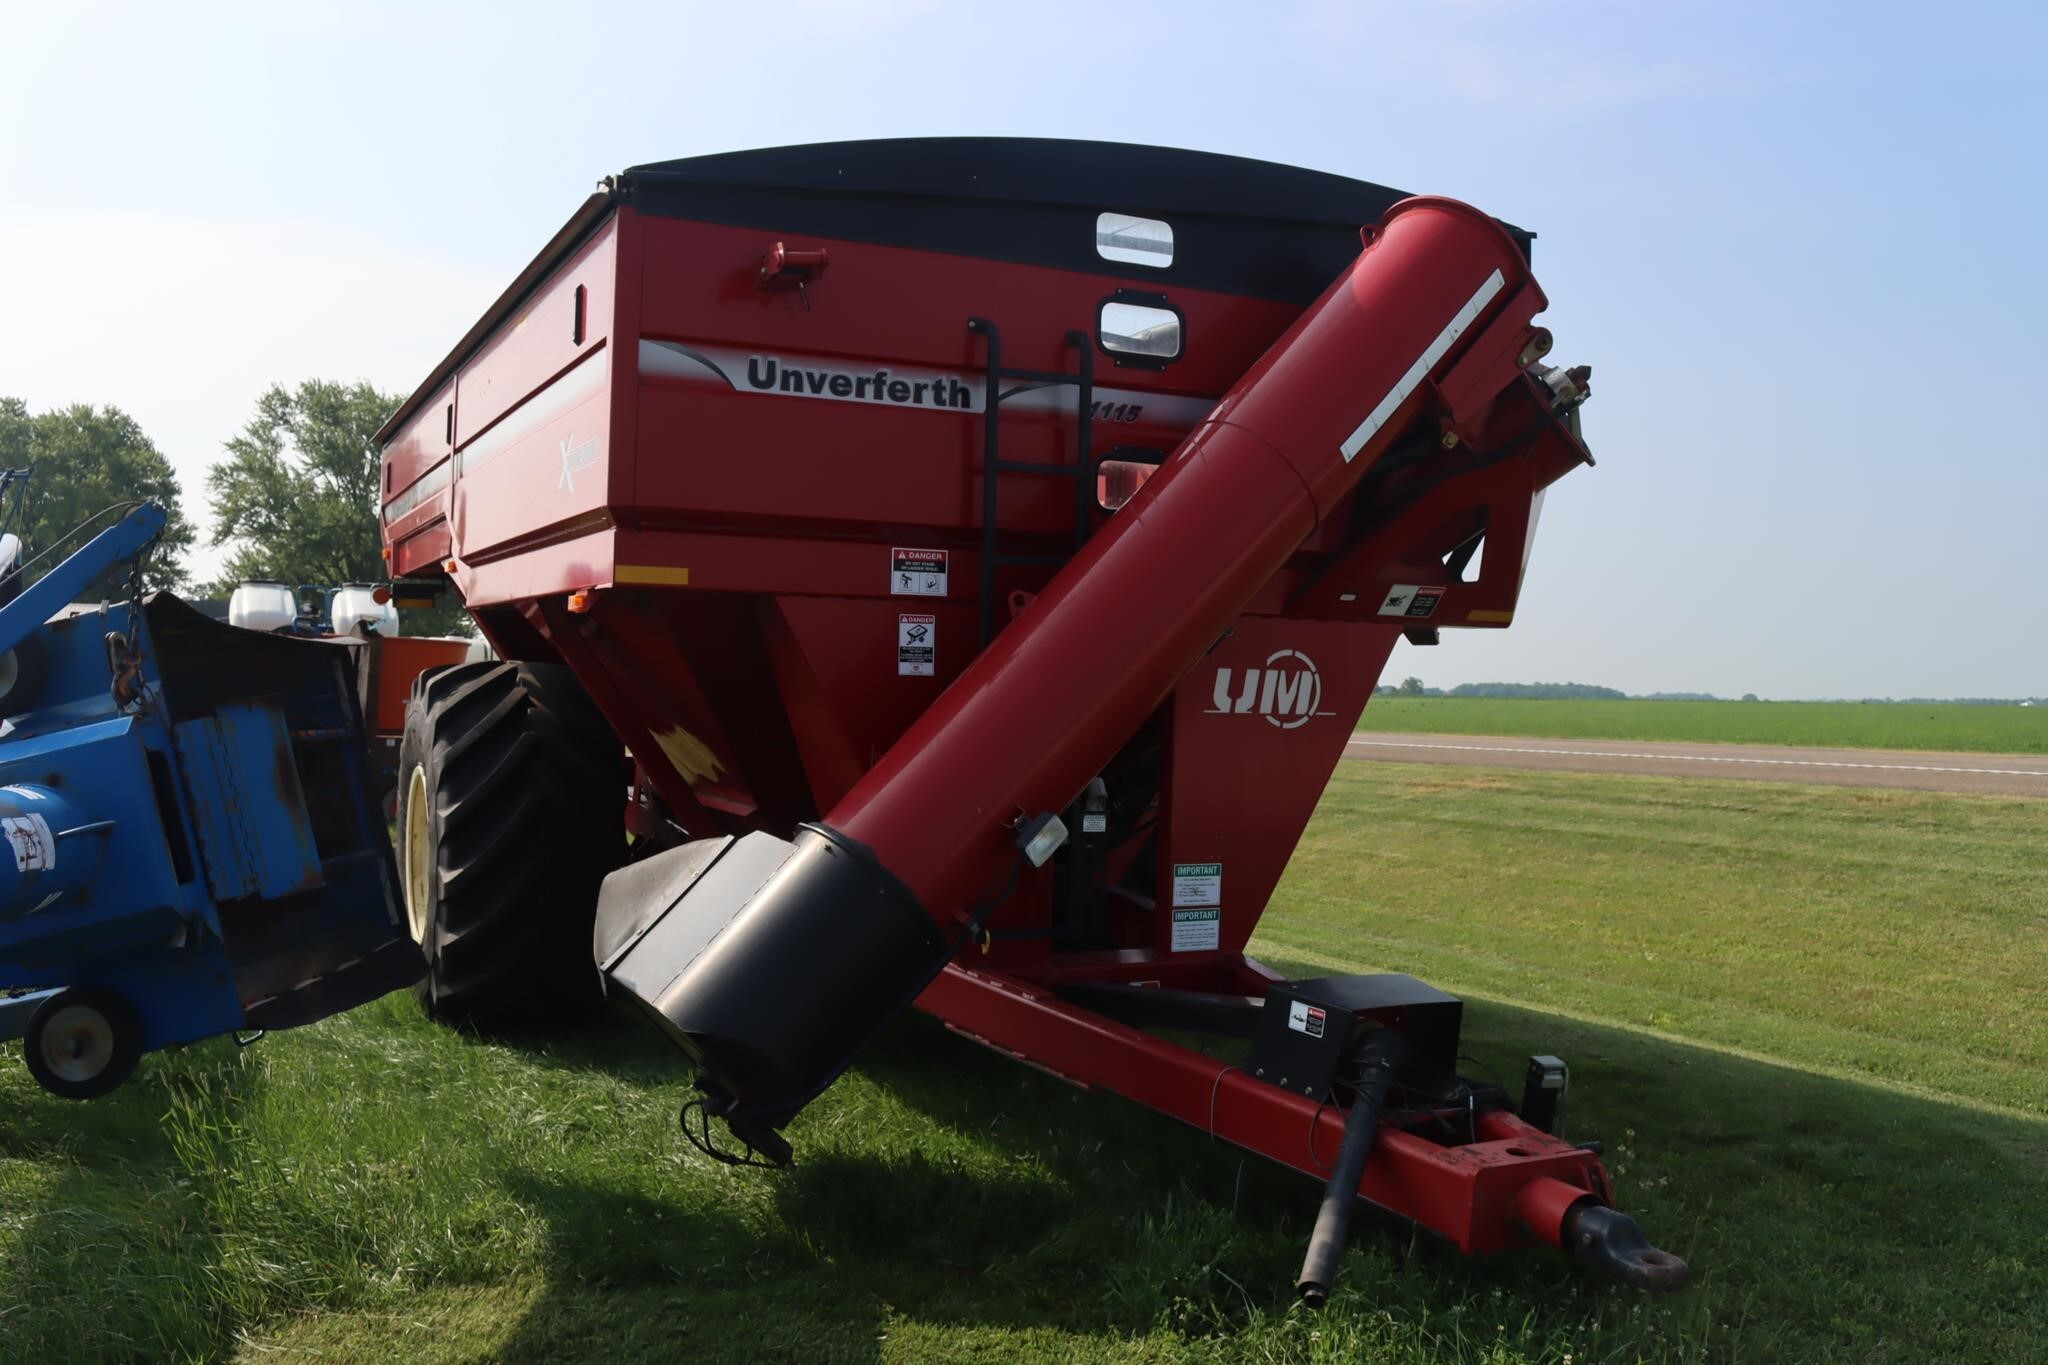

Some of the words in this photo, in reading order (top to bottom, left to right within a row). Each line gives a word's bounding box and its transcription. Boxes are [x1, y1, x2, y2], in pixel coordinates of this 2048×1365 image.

[748, 358, 971, 409] Unverferth
[1090, 401, 1143, 421] 1115
[908, 551, 943, 560] DANGER
[1177, 865, 1218, 876] IMPORTANT
[1175, 910, 1217, 920] IMPORTANT
